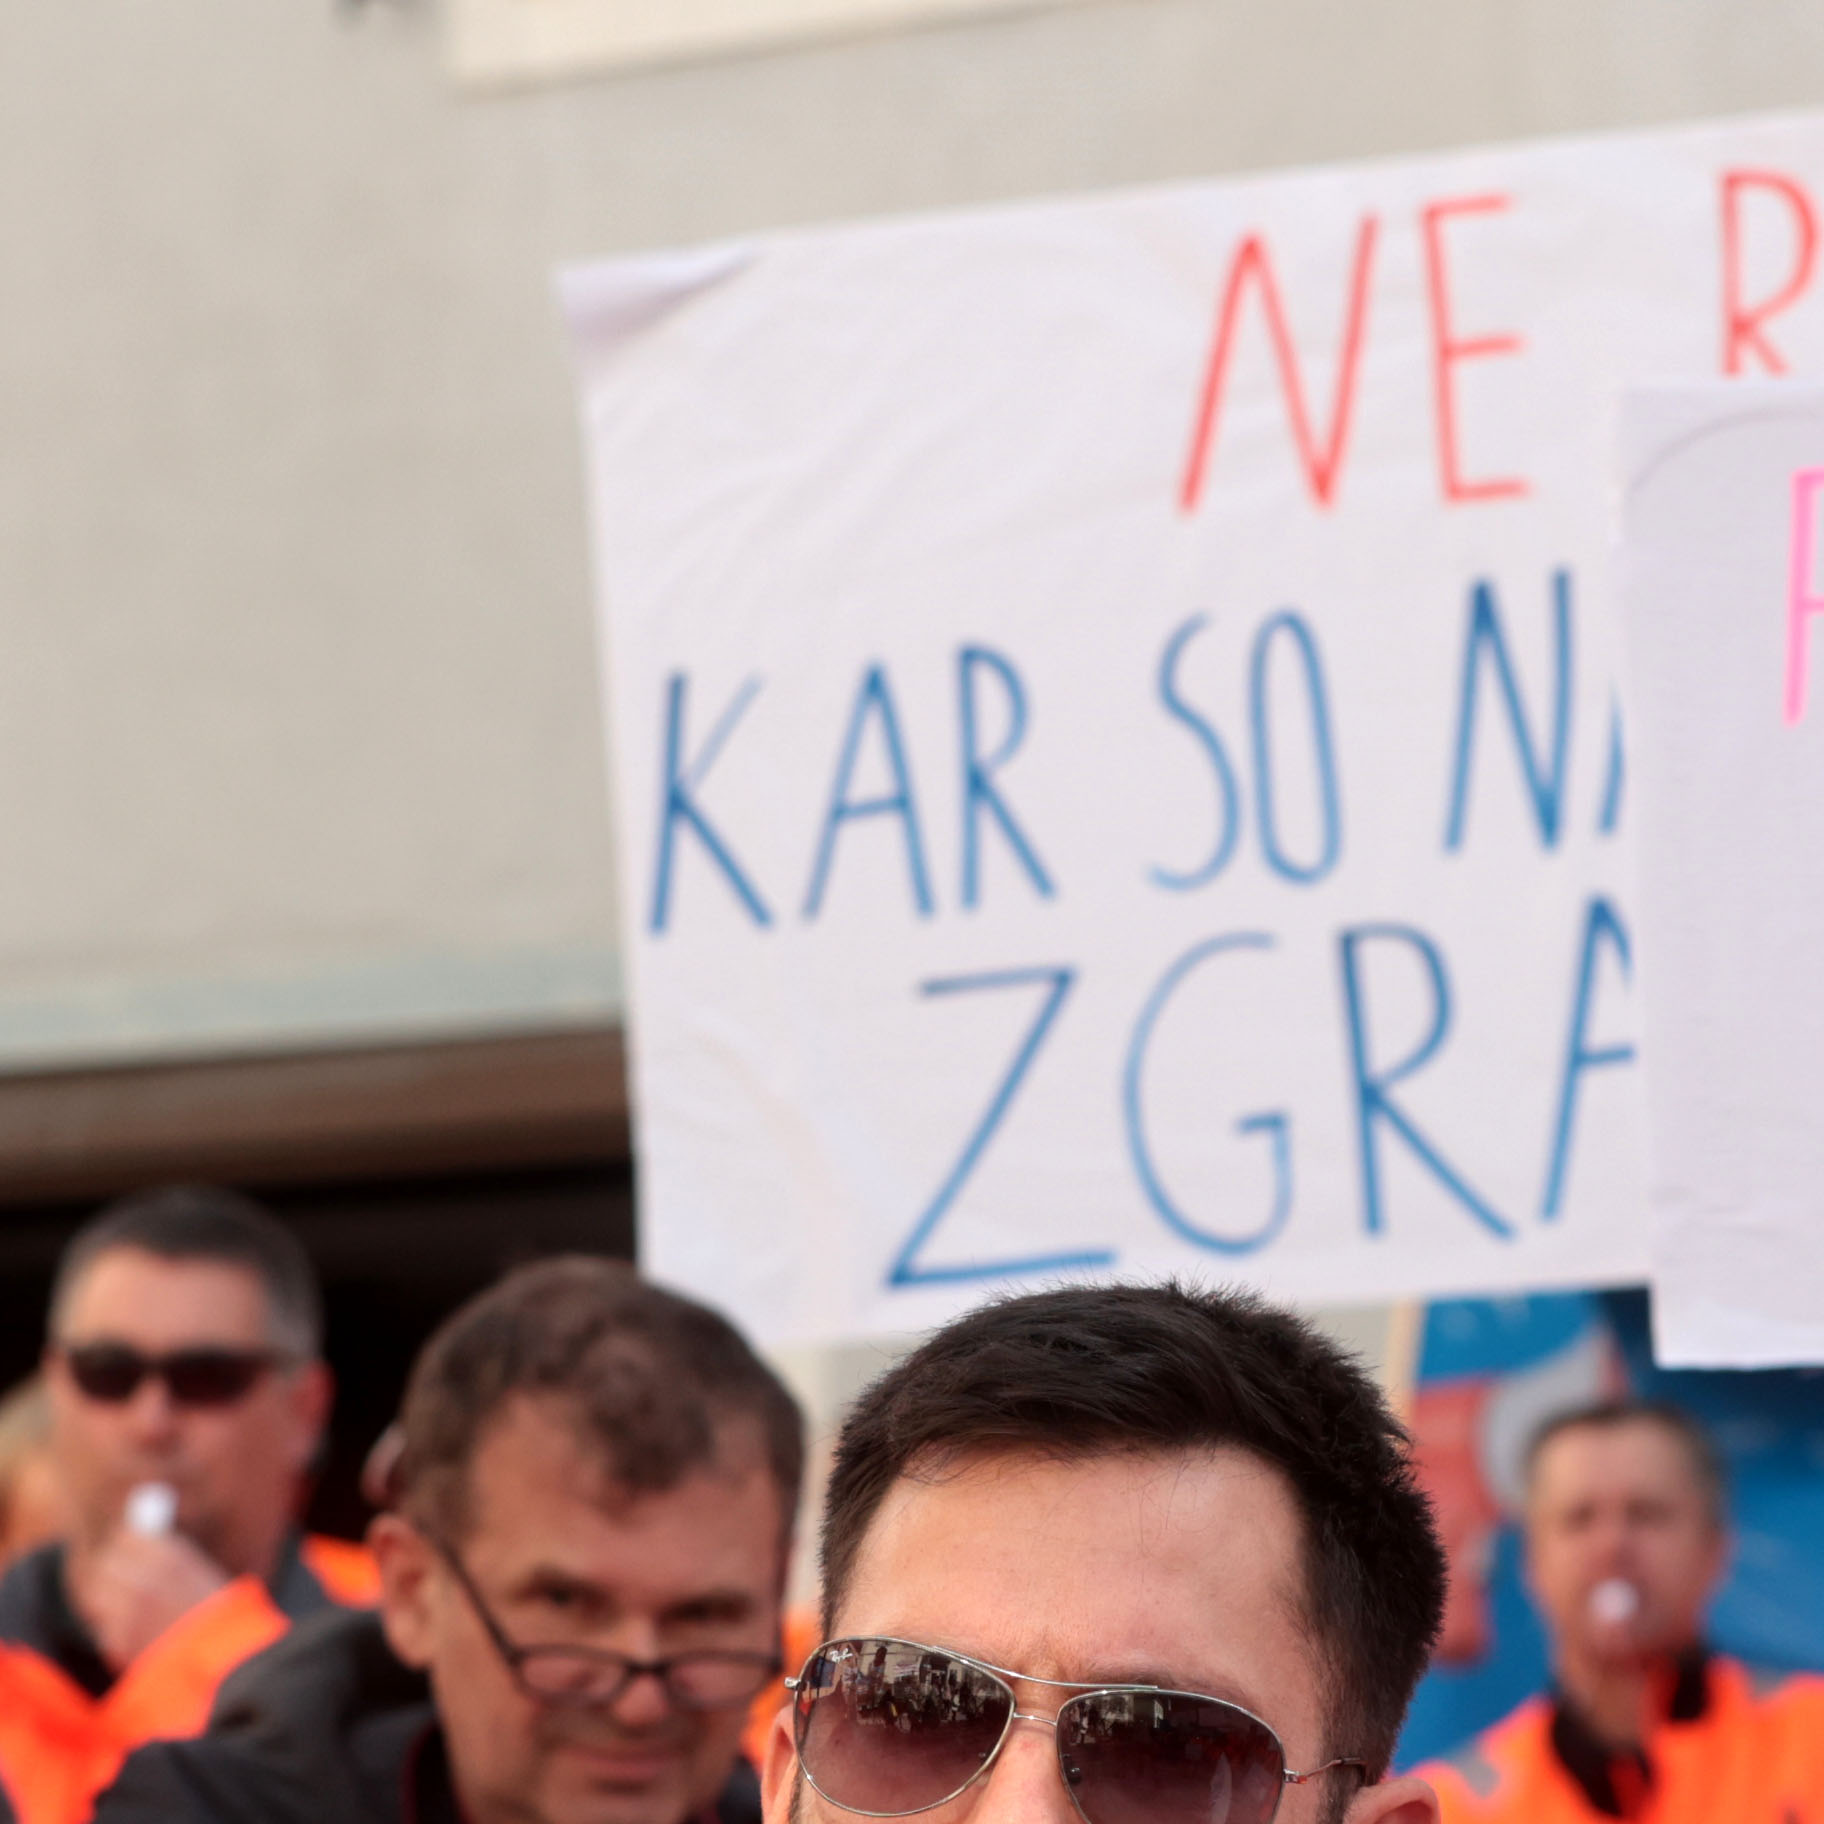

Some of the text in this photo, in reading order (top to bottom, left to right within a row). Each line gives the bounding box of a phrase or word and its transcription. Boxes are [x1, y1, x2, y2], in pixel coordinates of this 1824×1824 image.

[1180, 192, 1531, 514] NE
[648, 569, 1626, 937] KAR SO N
